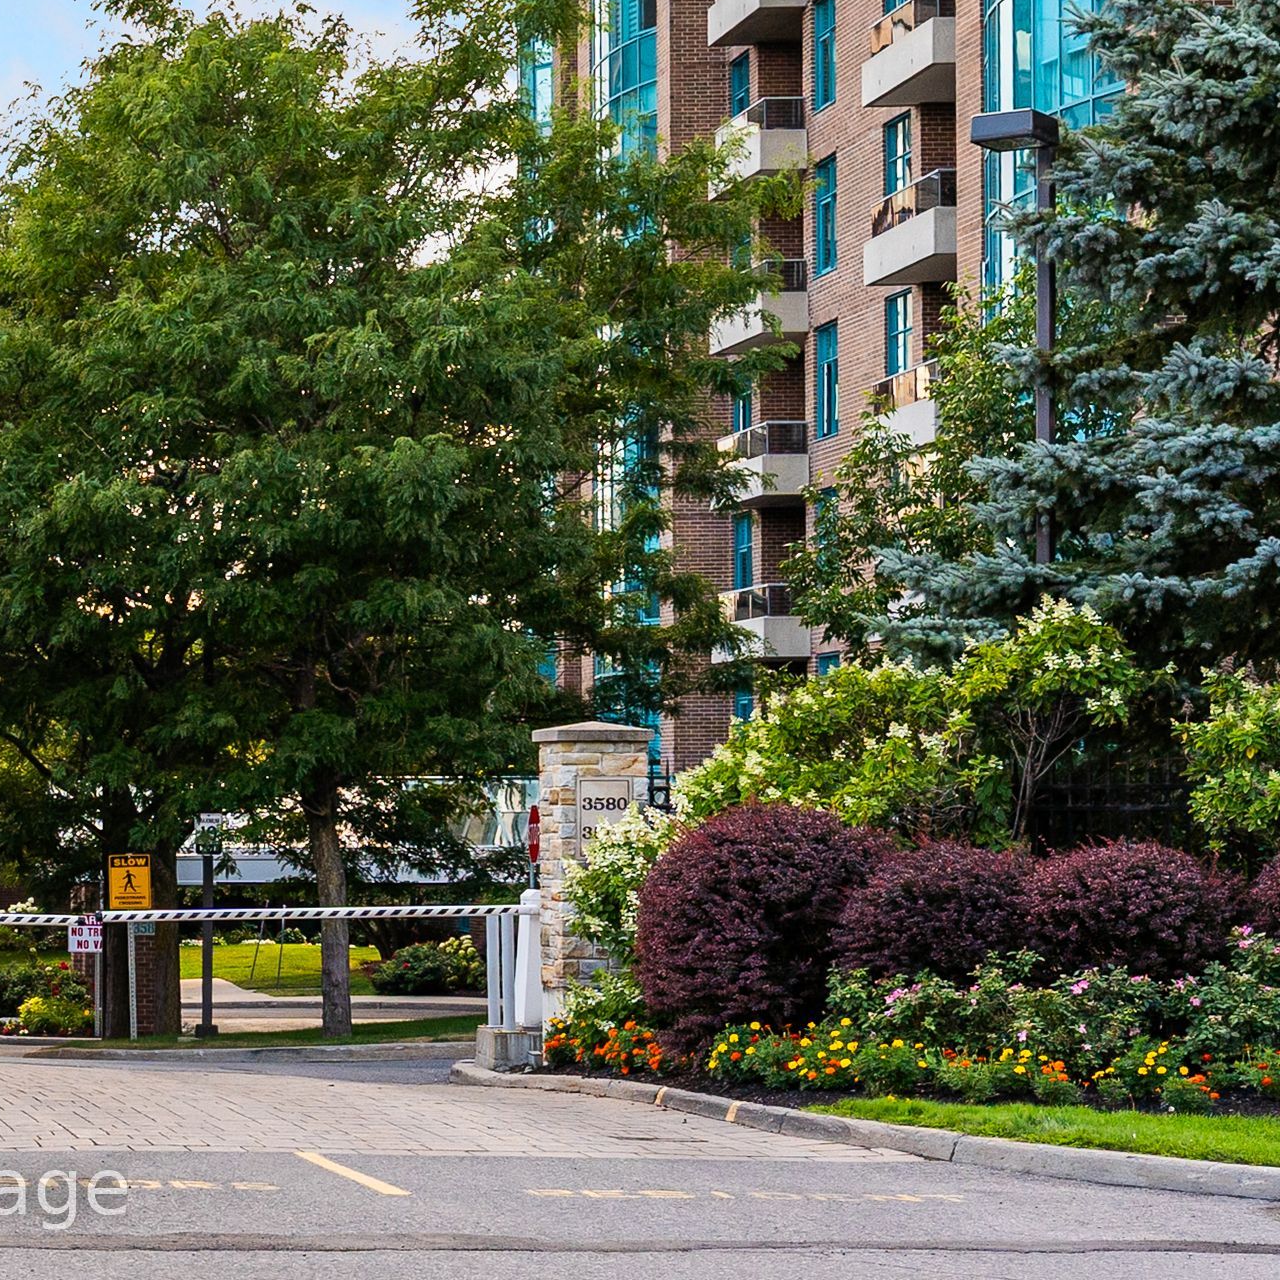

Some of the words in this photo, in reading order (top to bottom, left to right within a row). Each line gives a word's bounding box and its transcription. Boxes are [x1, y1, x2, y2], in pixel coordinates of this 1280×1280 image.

[582, 797, 628, 811] 3580
[113, 858, 146, 866] SLOW
[71, 927, 84, 937] NO
[87, 927, 102, 937] TR
[77, 939, 89, 949] NO
